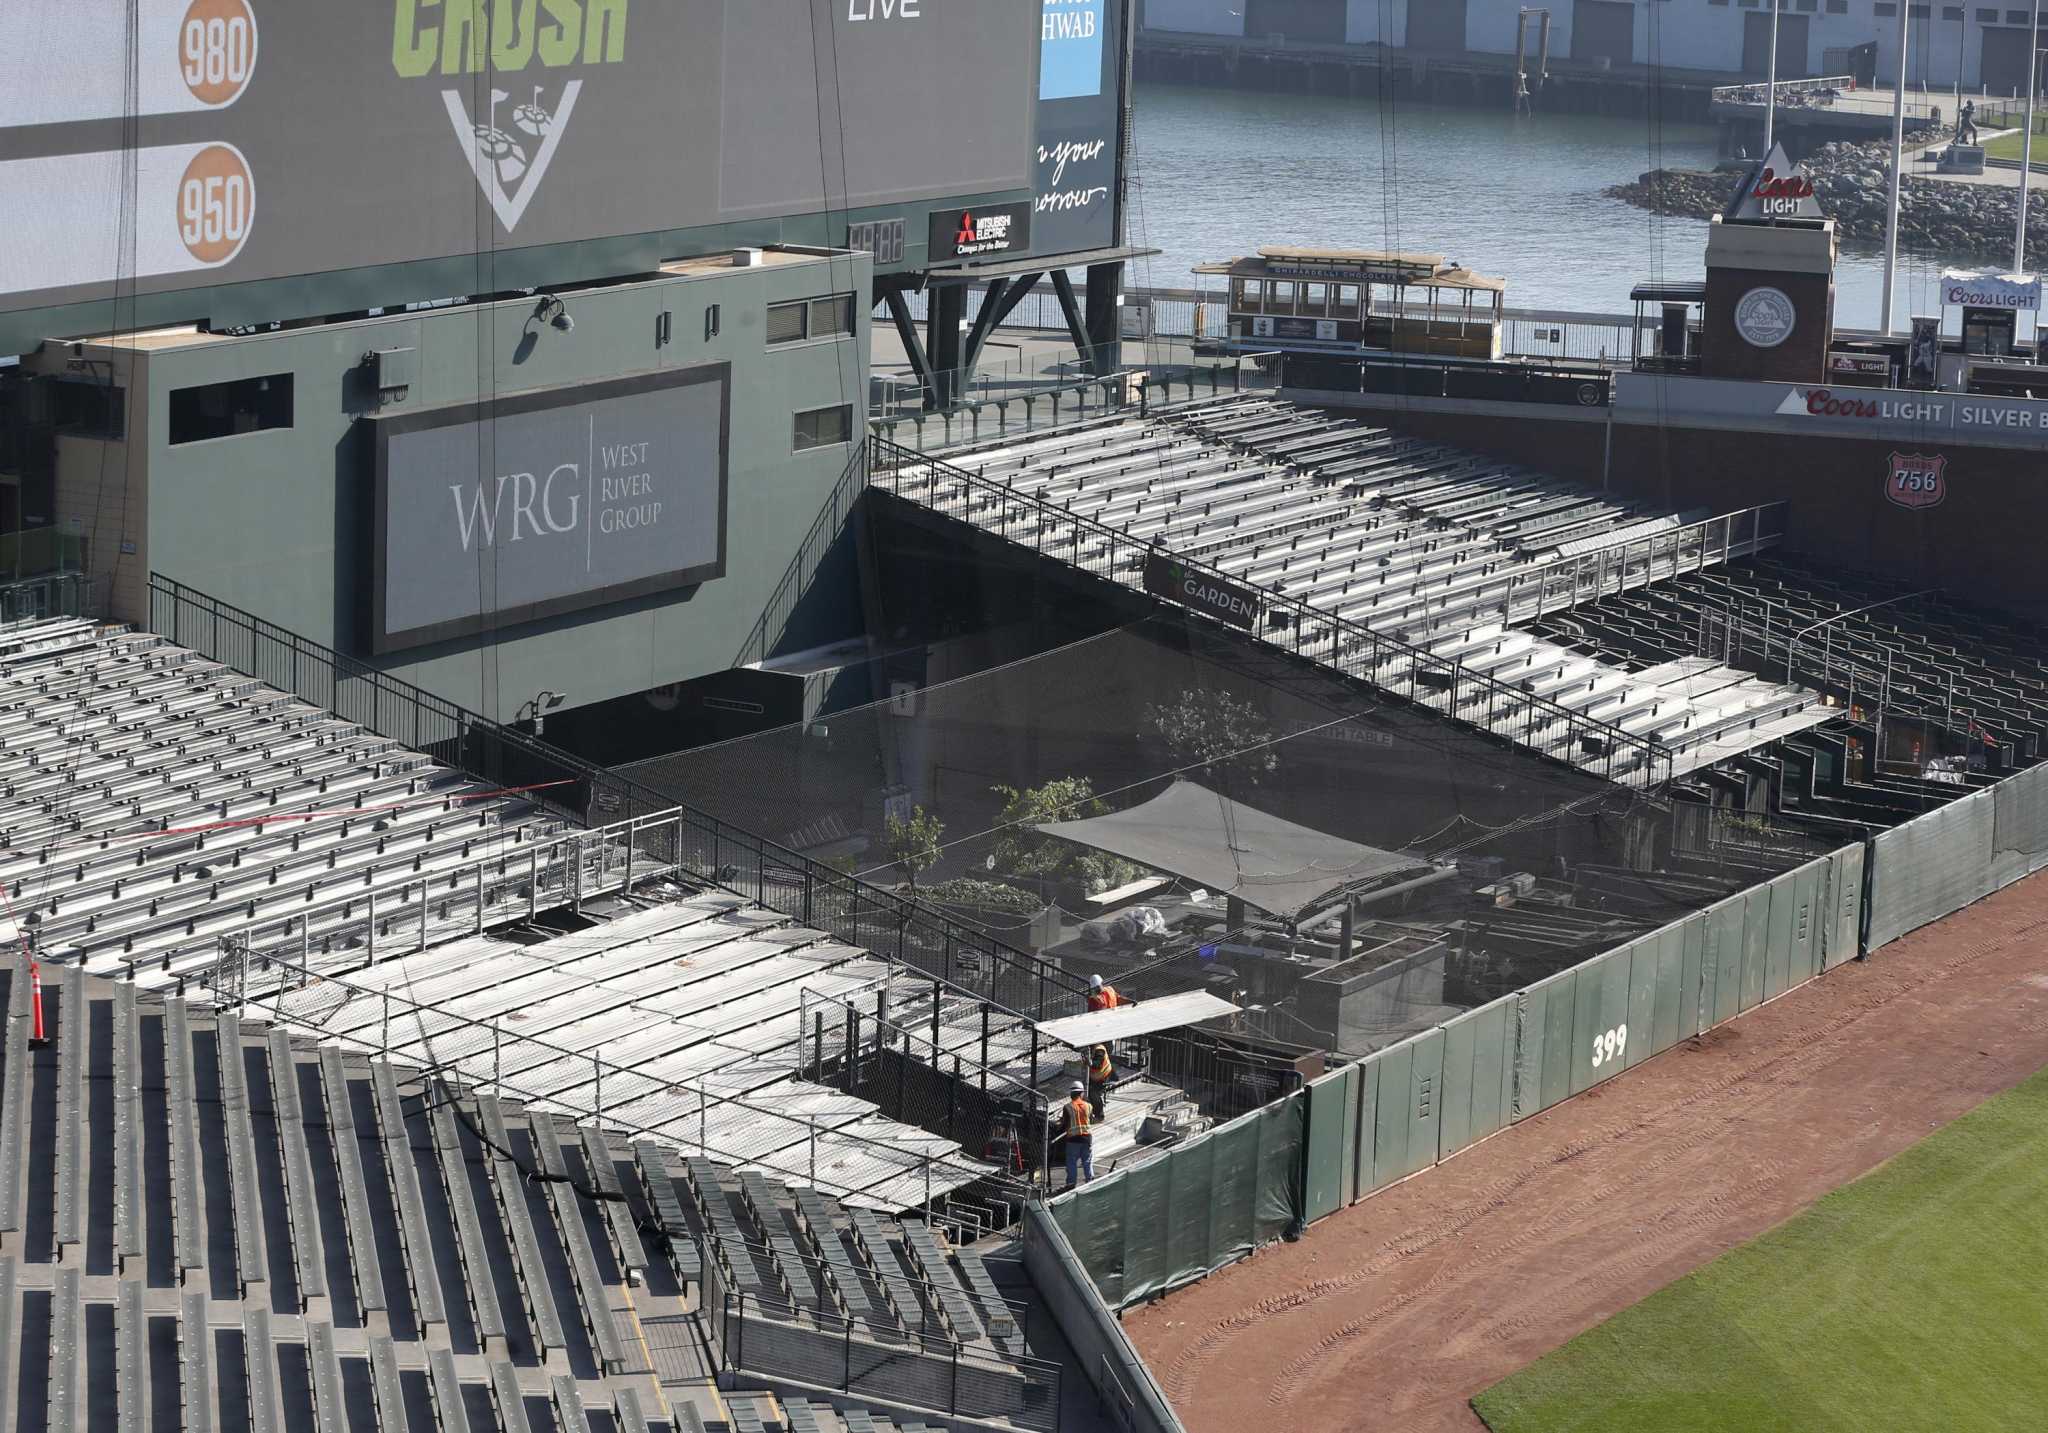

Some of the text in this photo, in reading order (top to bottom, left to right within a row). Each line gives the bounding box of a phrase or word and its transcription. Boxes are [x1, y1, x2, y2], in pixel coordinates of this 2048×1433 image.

[848, 0, 920, 21] LIVE
[185, 16, 247, 86] 980
[1050, 139, 1104, 186] your
[183, 175, 244, 245] 950
[1763, 198, 1802, 214] LIGHT
[976, 215, 1011, 230] MITSUBISHI
[976, 227, 1006, 240] ELECTRIC
[1274, 267, 1398, 280] GHIRARDELLI CHOCOLATE
[1948, 286, 2036, 307] Coors LIGHT
[1861, 362, 1884, 372] LIGHT
[1806, 389, 1879, 418] Coors
[1881, 401, 1944, 422] LIGHT
[1961, 406, 2033, 428] SILVER
[602, 442, 649, 472] WEST
[602, 473, 653, 502] RIVER
[1896, 470, 1936, 491] 756
[450, 463, 581, 552] WRG
[600, 503, 662, 533] GROUP
[1184, 579, 1253, 619] GARDEN
[1592, 1023, 1627, 1068] 399
